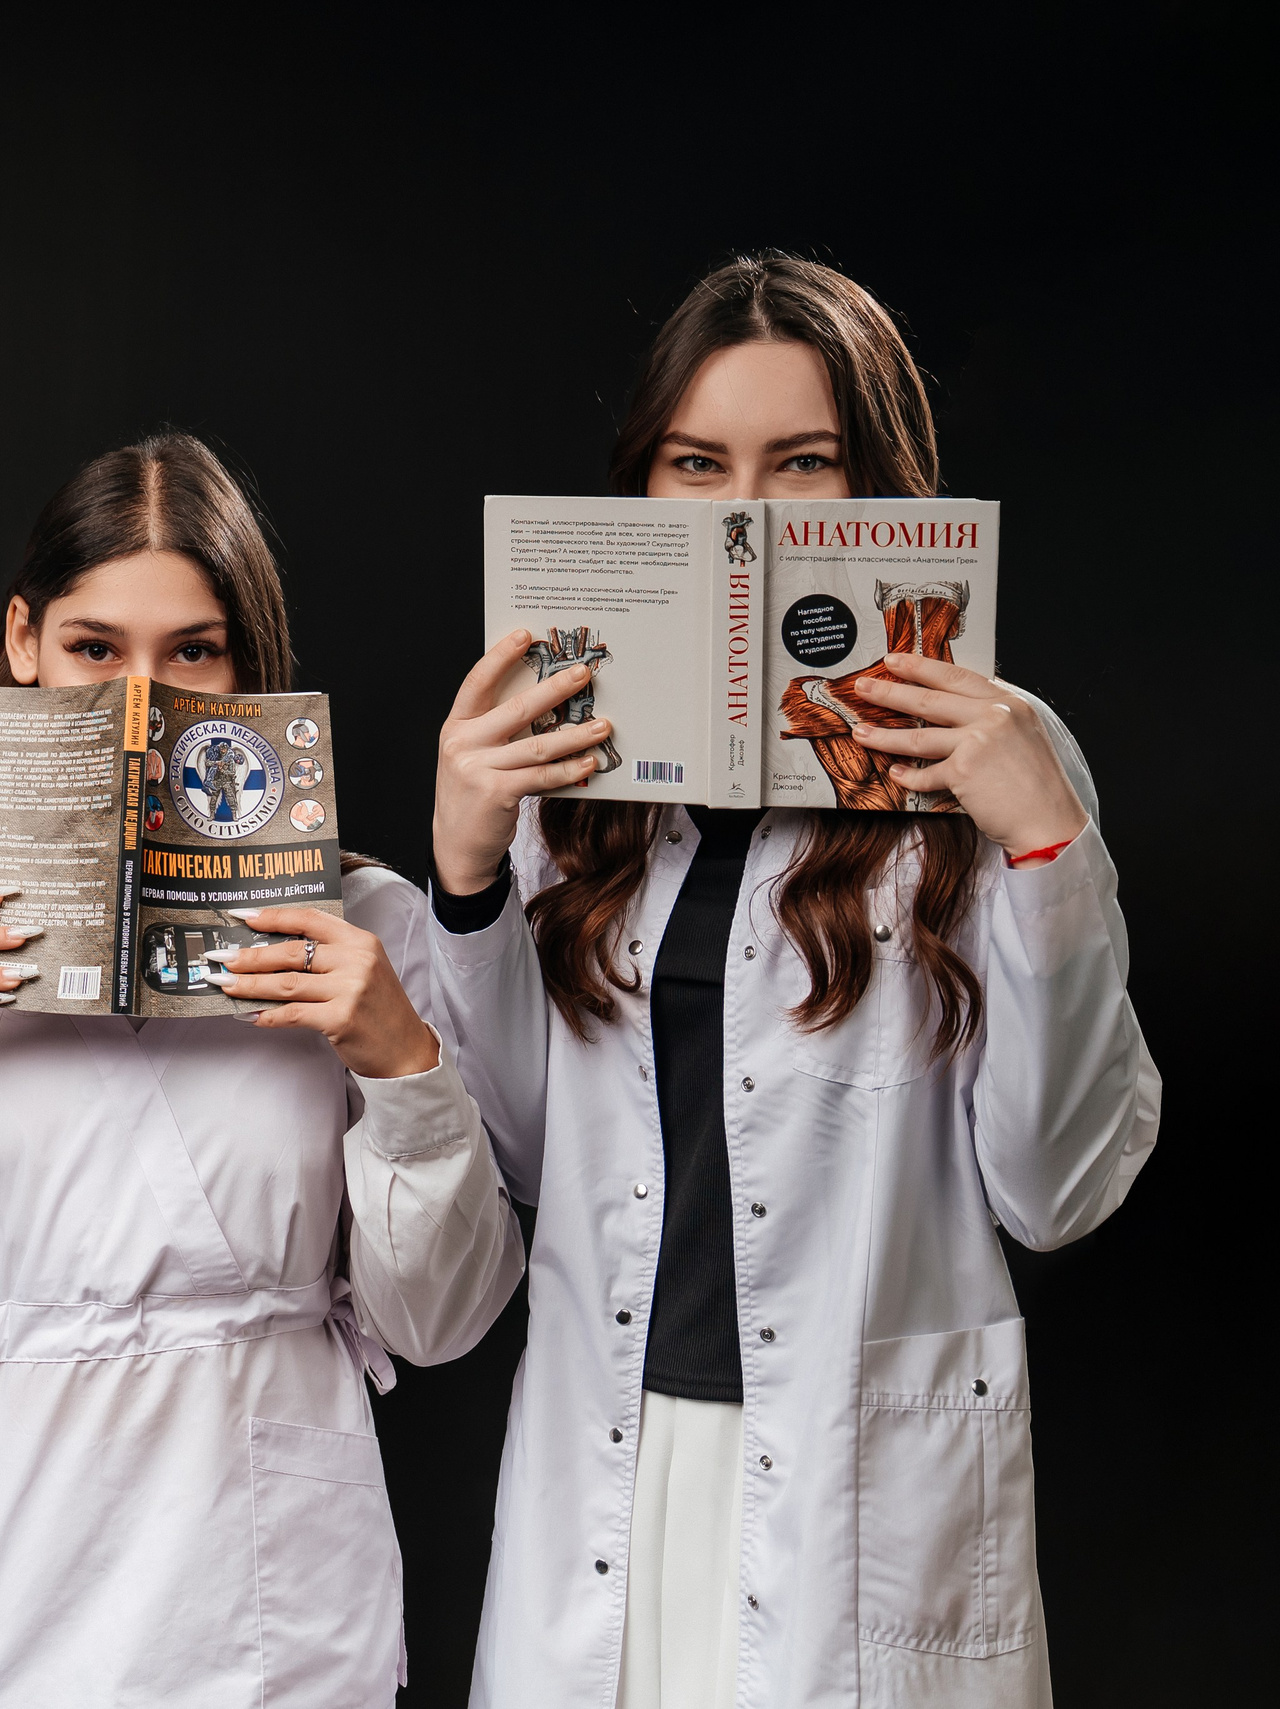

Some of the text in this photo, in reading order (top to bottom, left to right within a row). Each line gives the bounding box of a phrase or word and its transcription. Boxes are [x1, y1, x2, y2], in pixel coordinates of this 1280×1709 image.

[777, 521, 979, 548] АНАТОМИЯ
[797, 606, 834, 616] Наглядное
[802, 616, 832, 625] пособие
[810, 633, 845, 643] студентов
[815, 623, 848, 632] человека
[728, 573, 750, 728] АНАТОМИЯ
[805, 643, 846, 655] художников
[131, 684, 143, 746] АРТЁМ КАТУЛИН
[173, 697, 262, 717] АРТЁМ КАТУЛИН
[171, 724, 227, 780] ТАКТИЧЕСКАЯ
[230, 726, 281, 784] МЕДИЦИНА
[728, 734, 736, 771] Кристофер
[772, 773, 816, 782] Кристофер
[772, 783, 804, 791] Джозеф
[124, 757, 141, 850] ТАКТИЧЕСКАЯ МЕДИЦИНА
[176, 795, 277, 836] CITO CITISSIMO
[125, 860, 133, 883] ПЕРВАЯ
[143, 848, 324, 880] ТАКТИЧЕСКАЯ МЕДИЦИНА
[123, 884, 133, 910] ПОМОЩЬ
[142, 882, 325, 902] ПЕРВАЯ ПОМОЩЬ В УСЛОВИЯХ БОЕВЫХ ДЕЙСТВИЙ
[121, 917, 131, 949] УСЛОВИЯХ
[120, 950, 129, 974] БОЕВЫХ
[118, 974, 128, 1007] ДЕЙСТВИЙ
